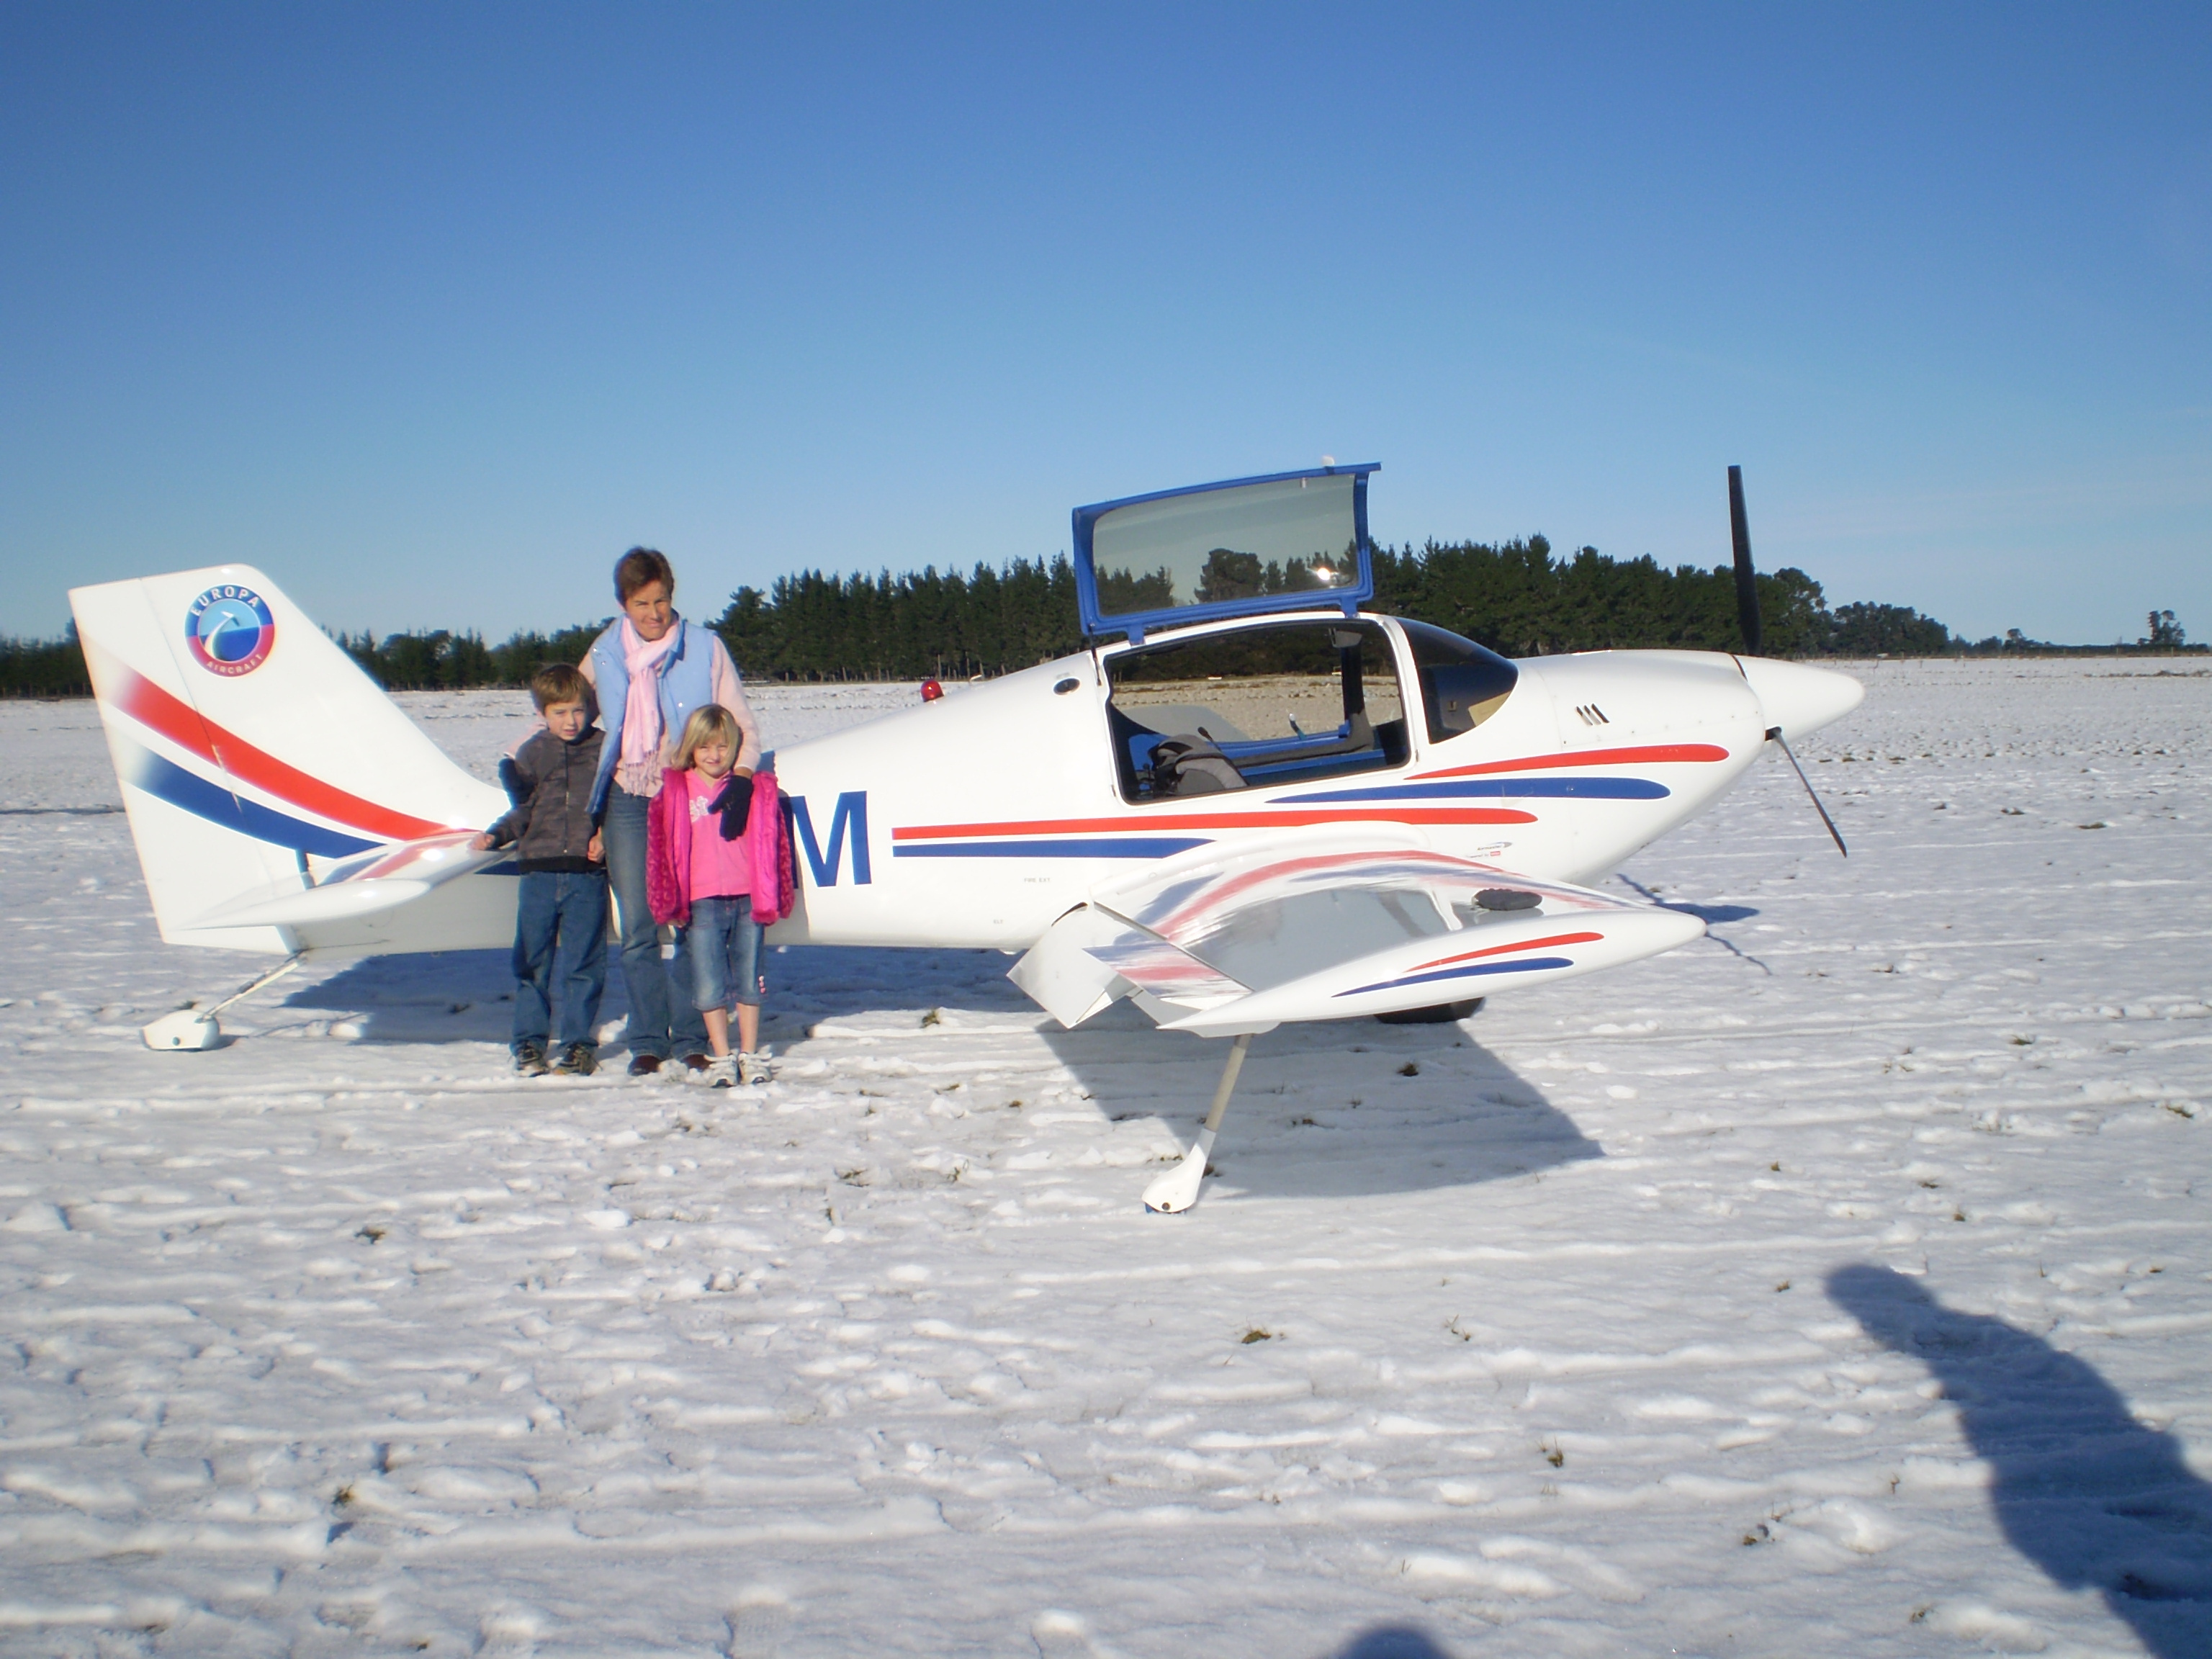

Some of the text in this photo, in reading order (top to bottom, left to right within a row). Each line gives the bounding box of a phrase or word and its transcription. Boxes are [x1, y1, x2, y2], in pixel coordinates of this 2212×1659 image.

[190, 586, 260, 616] EUROPA
[207, 654, 263, 674] AIRCRAFT
[778, 790, 872, 889] M
